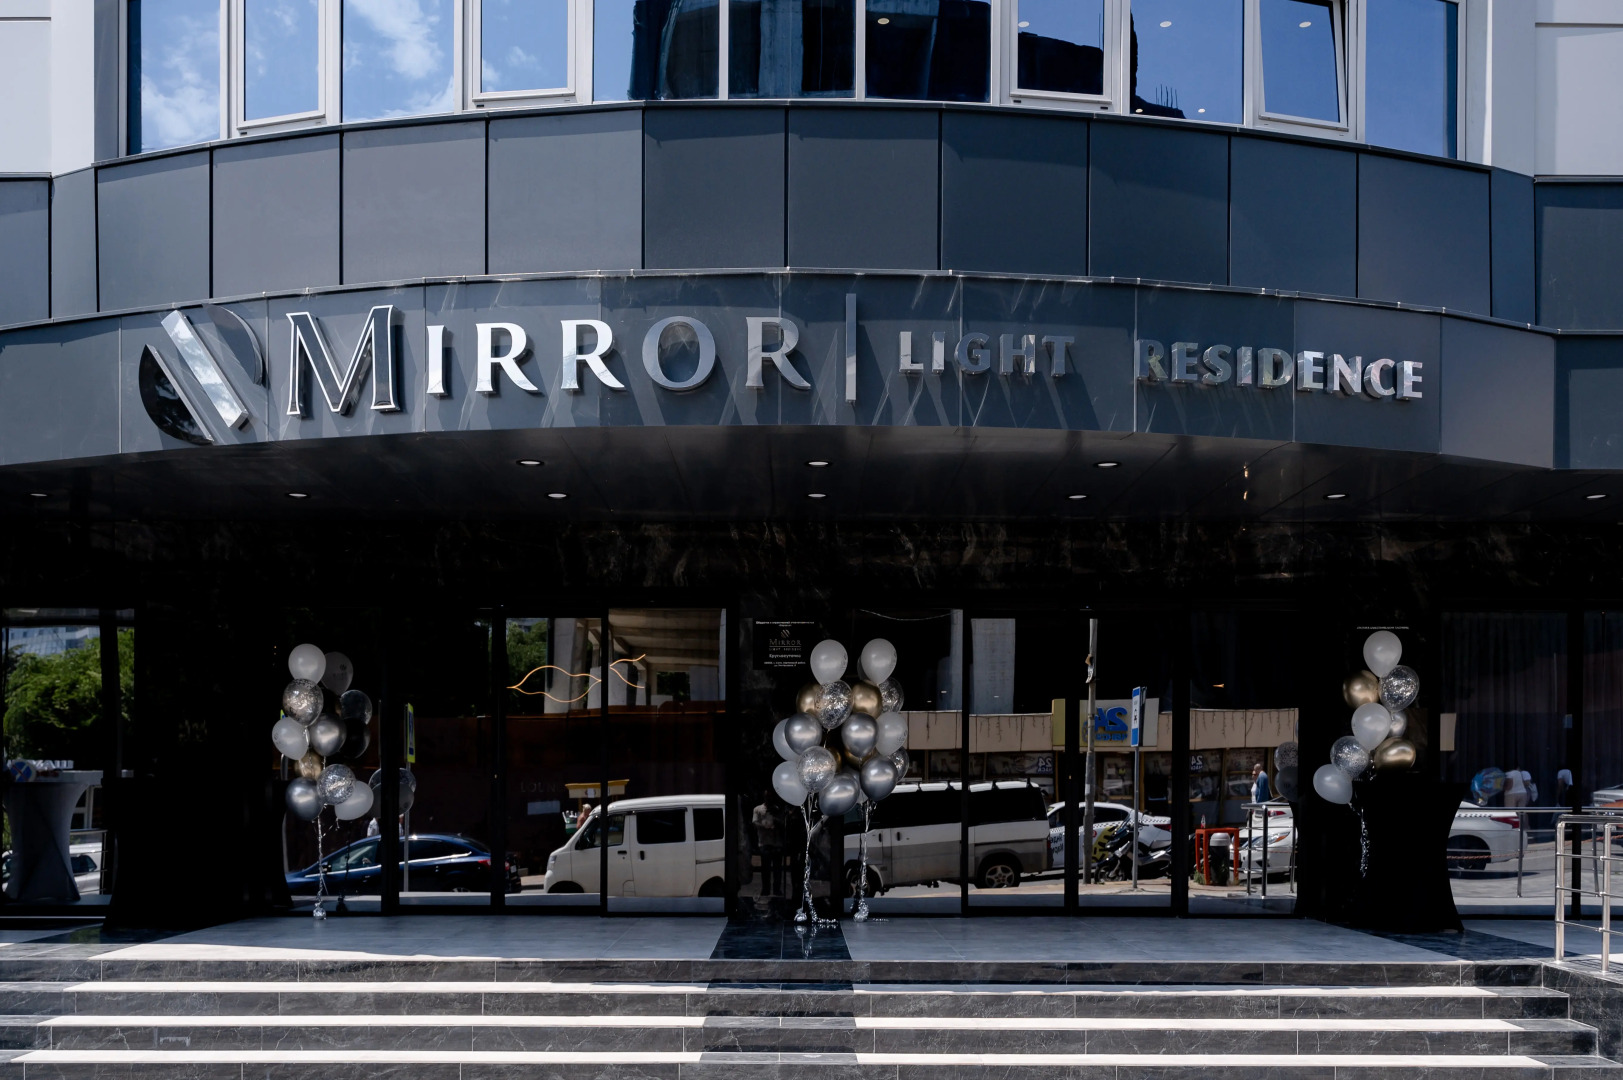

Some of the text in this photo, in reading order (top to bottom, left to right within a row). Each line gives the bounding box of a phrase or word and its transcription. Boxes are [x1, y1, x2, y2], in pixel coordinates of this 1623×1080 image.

[286, 305, 1424, 416] MIRROR LIGHT RESIDENCE
